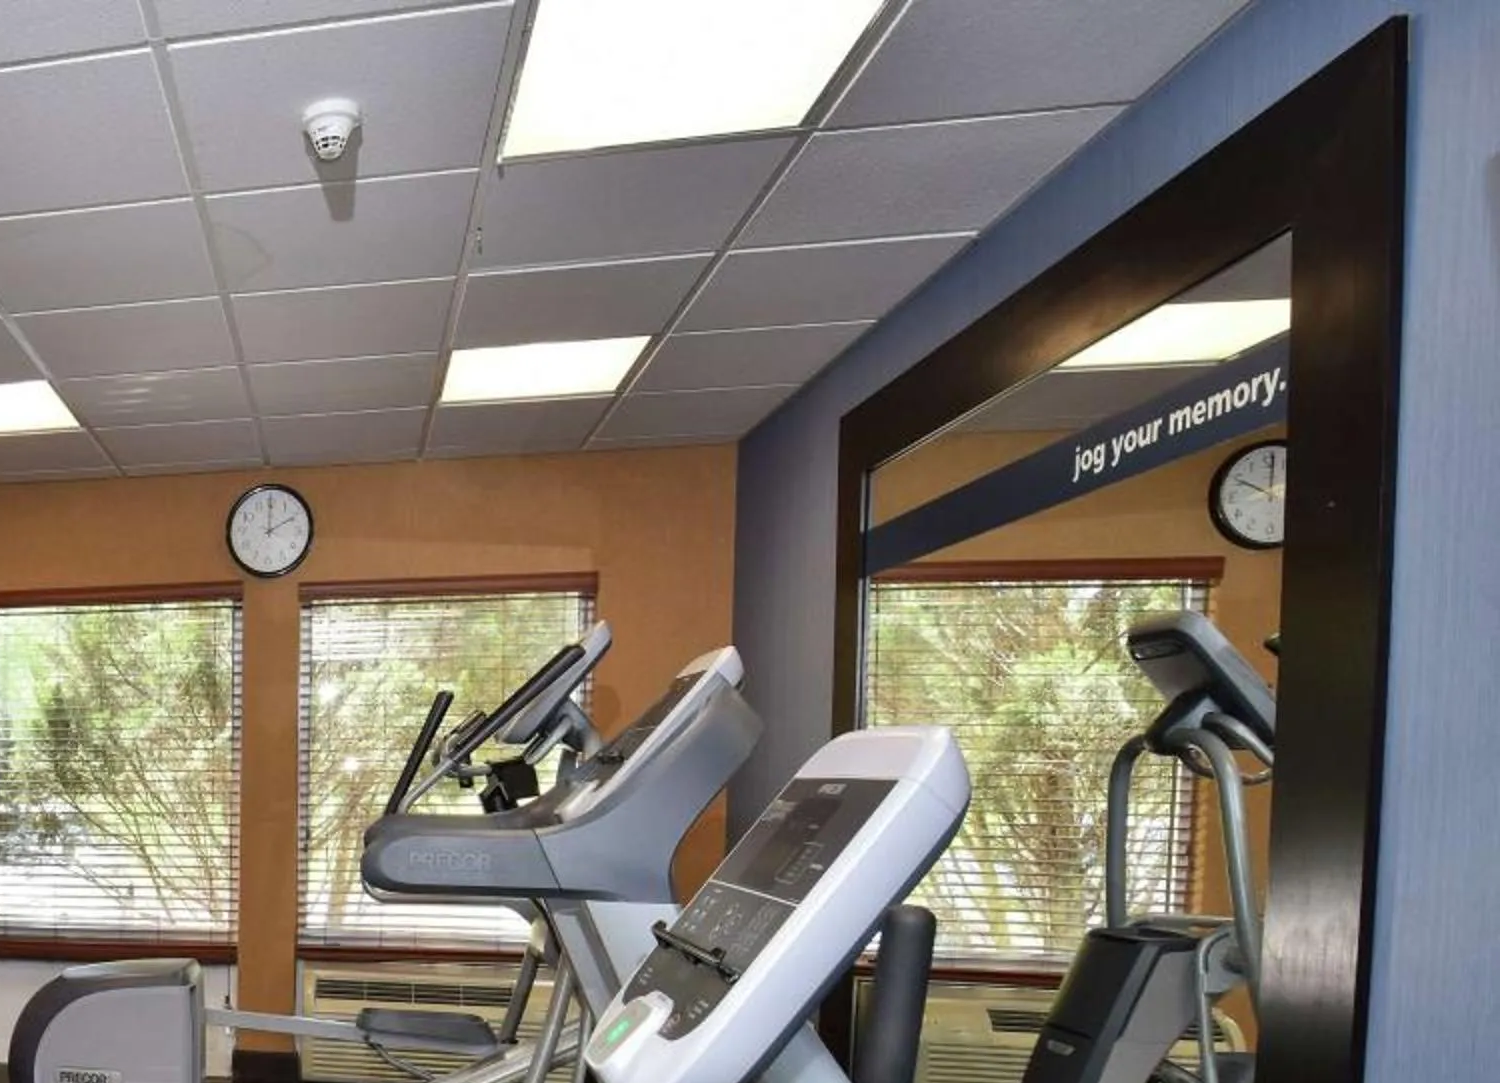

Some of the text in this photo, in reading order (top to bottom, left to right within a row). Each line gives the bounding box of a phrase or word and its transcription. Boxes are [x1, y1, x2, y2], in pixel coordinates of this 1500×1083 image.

[1072, 366, 1288, 483] jog your memory.
